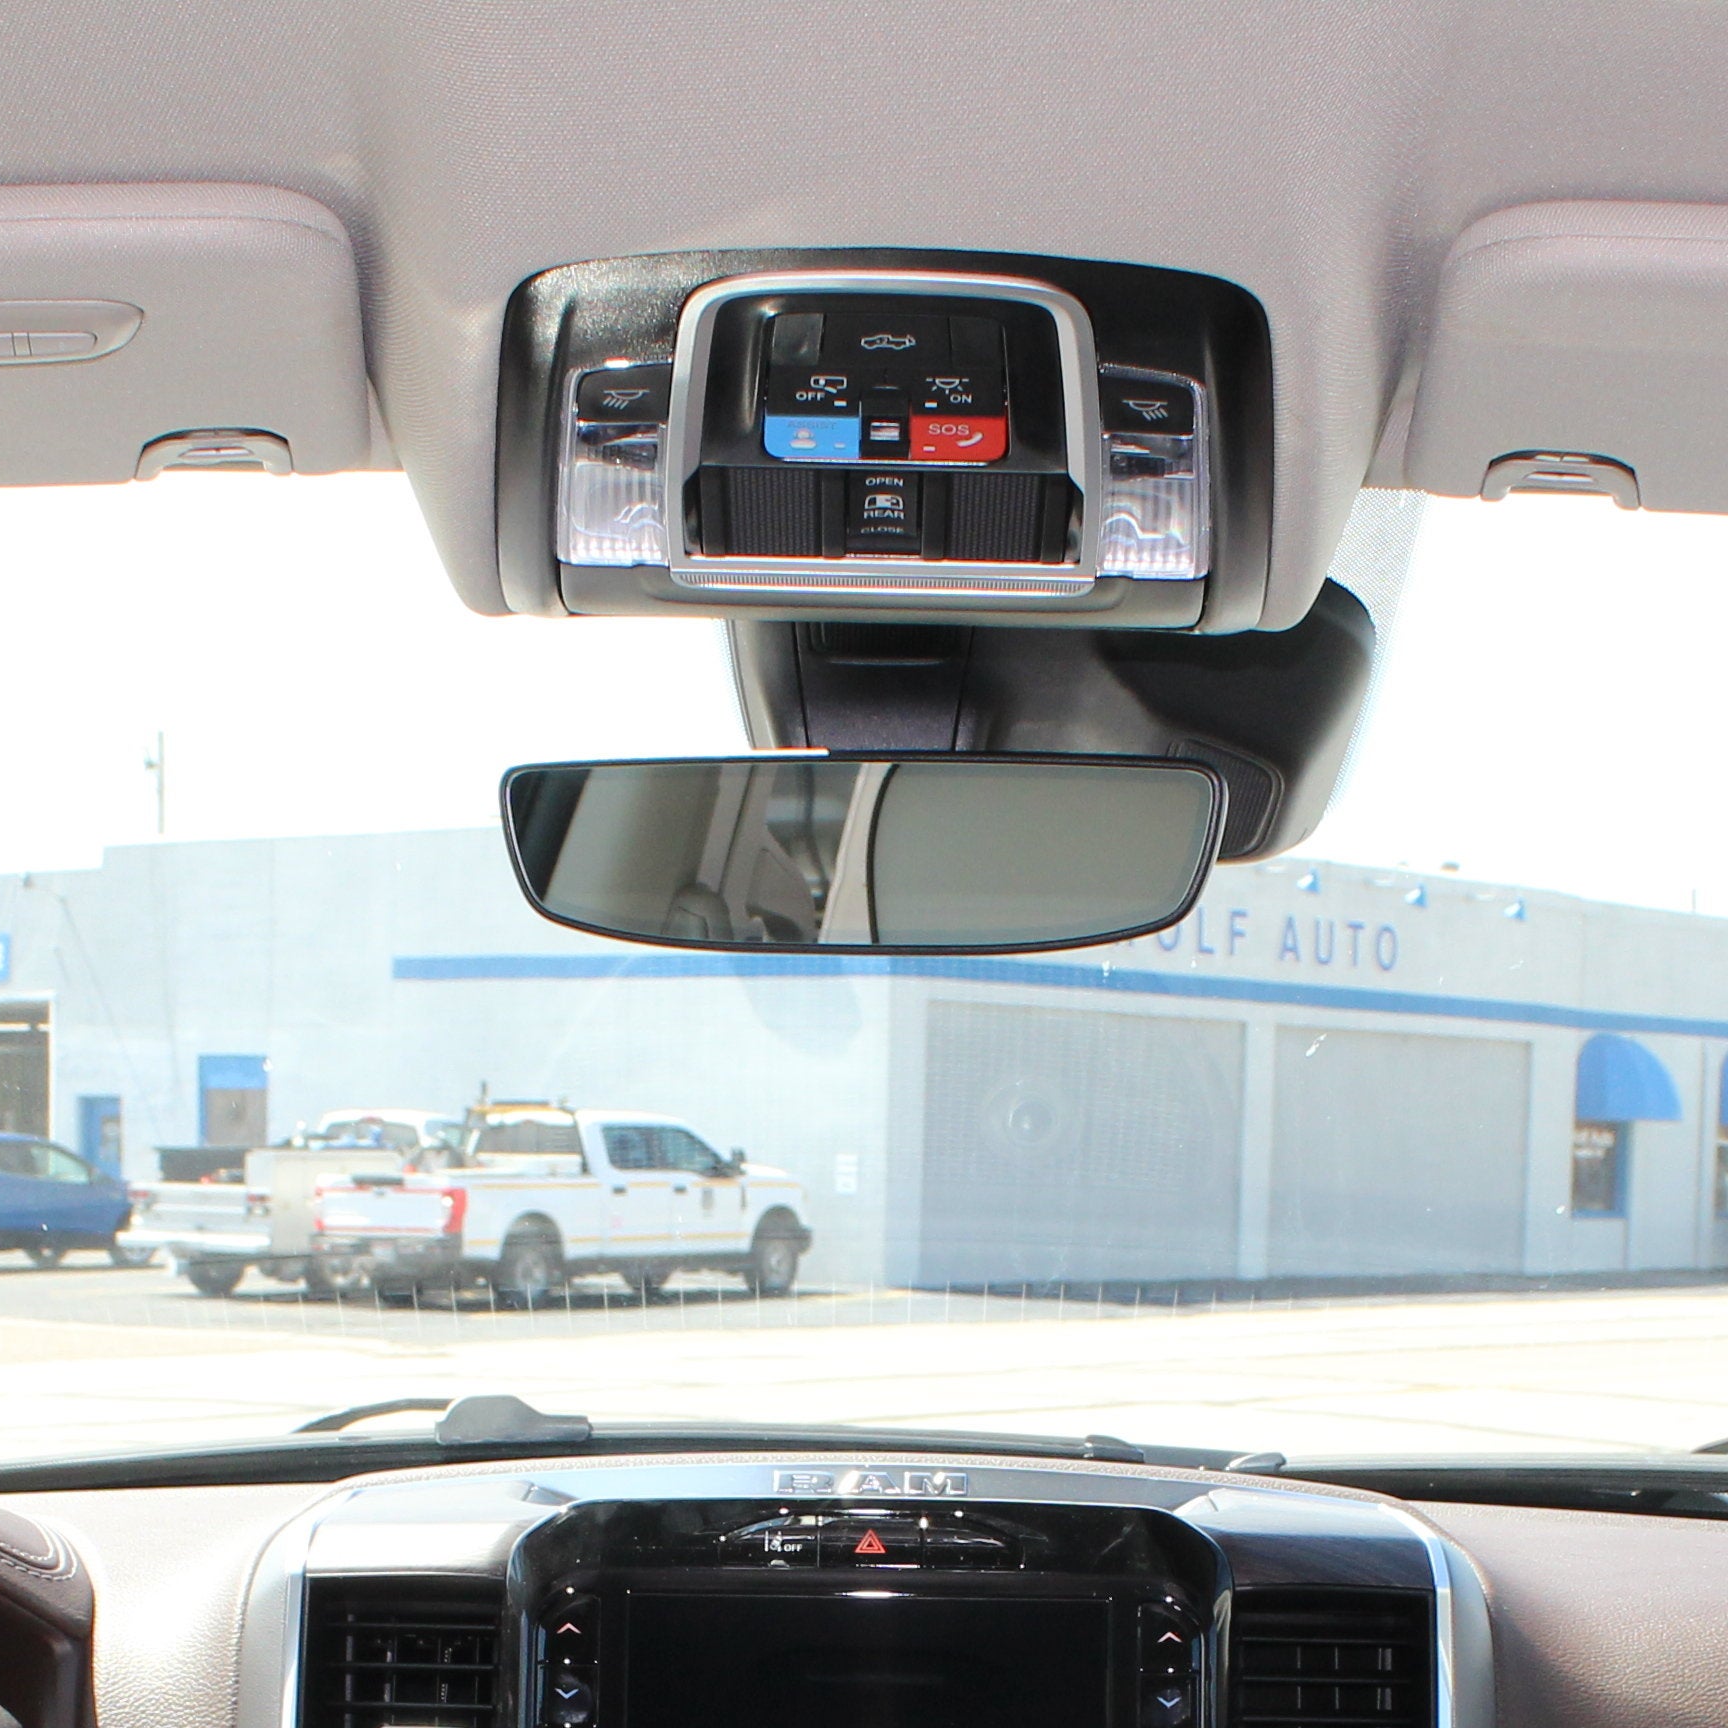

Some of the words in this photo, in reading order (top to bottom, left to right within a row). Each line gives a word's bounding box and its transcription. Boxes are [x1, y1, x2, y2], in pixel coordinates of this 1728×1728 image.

[795, 391, 825, 401] OFF
[950, 394, 972, 404] ON
[928, 424, 970, 436] SOS
[865, 477, 904, 487] OPEN
[863, 510, 905, 520] REAR
[860, 526, 905, 535] CLOSE
[1278, 913, 1401, 972] AUTO
[773, 1470, 969, 1496] RAM
[784, 1543, 803, 1553] OFF
